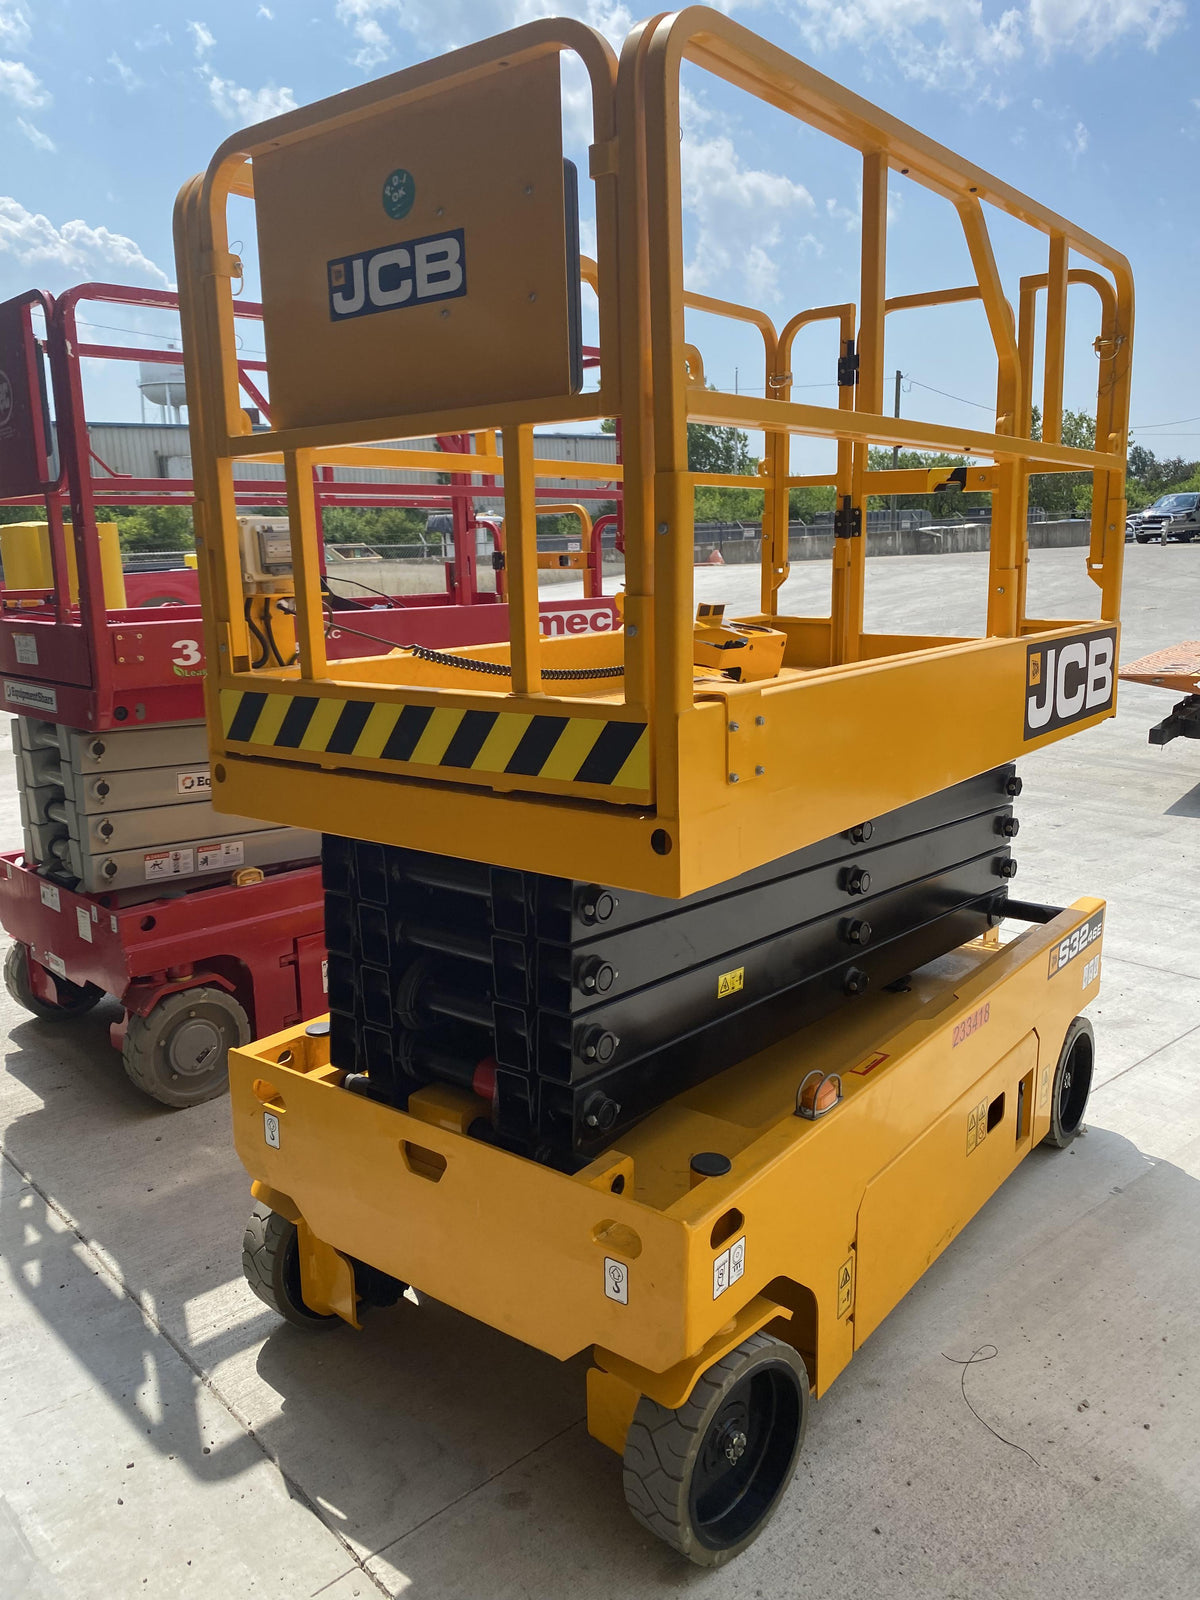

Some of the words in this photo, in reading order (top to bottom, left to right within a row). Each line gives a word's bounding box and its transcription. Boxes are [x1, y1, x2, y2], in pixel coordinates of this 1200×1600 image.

[333, 237, 463, 315] JCB
[539, 611, 612, 635] mec
[1028, 636, 1113, 729] JCB
[953, 1002, 991, 1048] 233418
